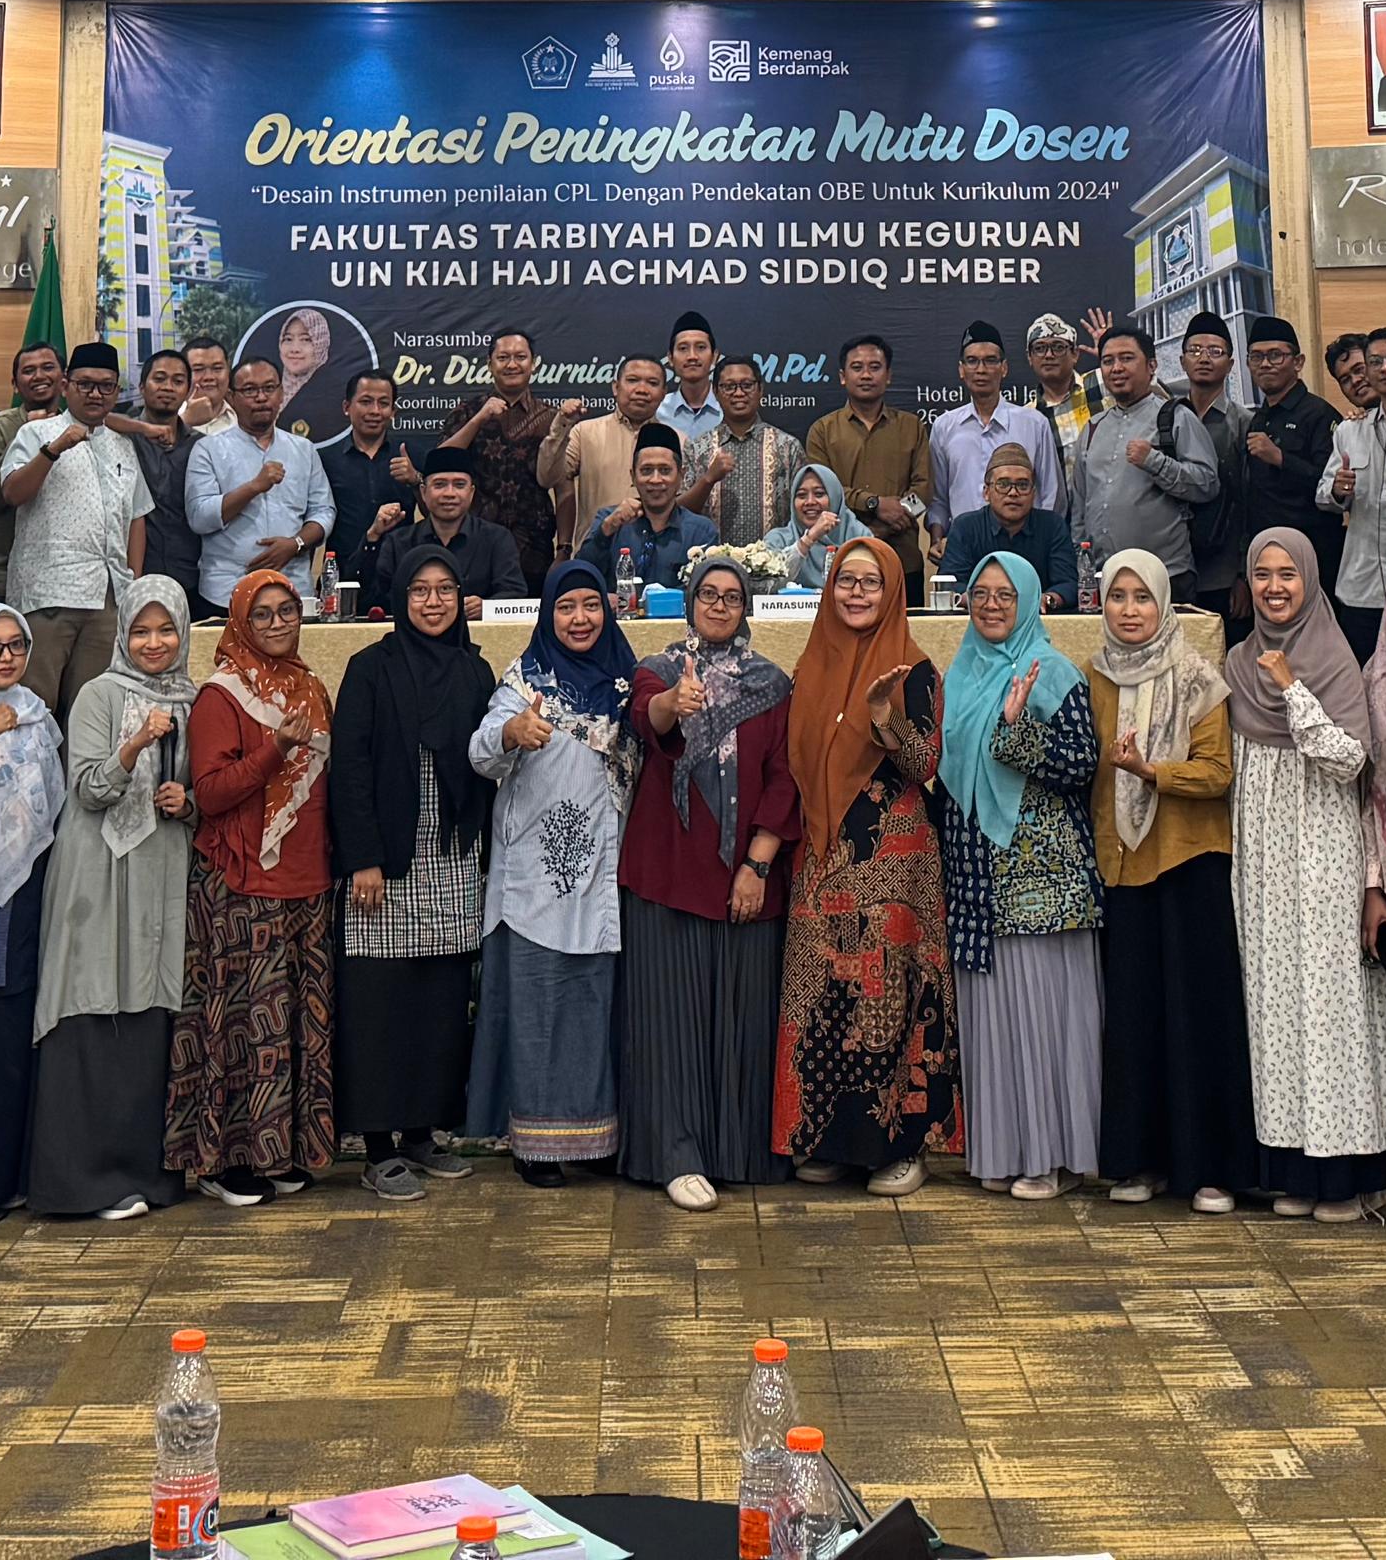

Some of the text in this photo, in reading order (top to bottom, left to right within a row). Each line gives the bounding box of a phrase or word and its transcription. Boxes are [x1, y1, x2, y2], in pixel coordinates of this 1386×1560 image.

[758, 47, 832, 63] Kemenag
[649, 71, 695, 88] pusaka
[758, 61, 850, 78] Berdampak
[244, 108, 1130, 174] Orientasi Peningkatan Mutu Dosen
[341, 184, 447, 203] Instrumen
[455, 183, 547, 207] penilaian
[554, 183, 598, 203] CPL
[605, 183, 684, 206] Dengan
[691, 182, 811, 201] Pendekatan
[818, 181, 865, 201] OBE
[872, 181, 935, 201] Untuk
[942, 181, 1050, 200] Kurikulum
[1057, 180, 1120, 200] 2024"
[290, 221, 1080, 251] FAKULTAS TARBIYAH DAN ILMU KEGURUAN
[330, 258, 1041, 289] UIN KIAI HAJI ACHMAD SIDDIQ JEMBER
[393, 331, 492, 347] Narasumbe
[392, 355, 436, 386] Dr.
[917, 385, 963, 402] Hotel
